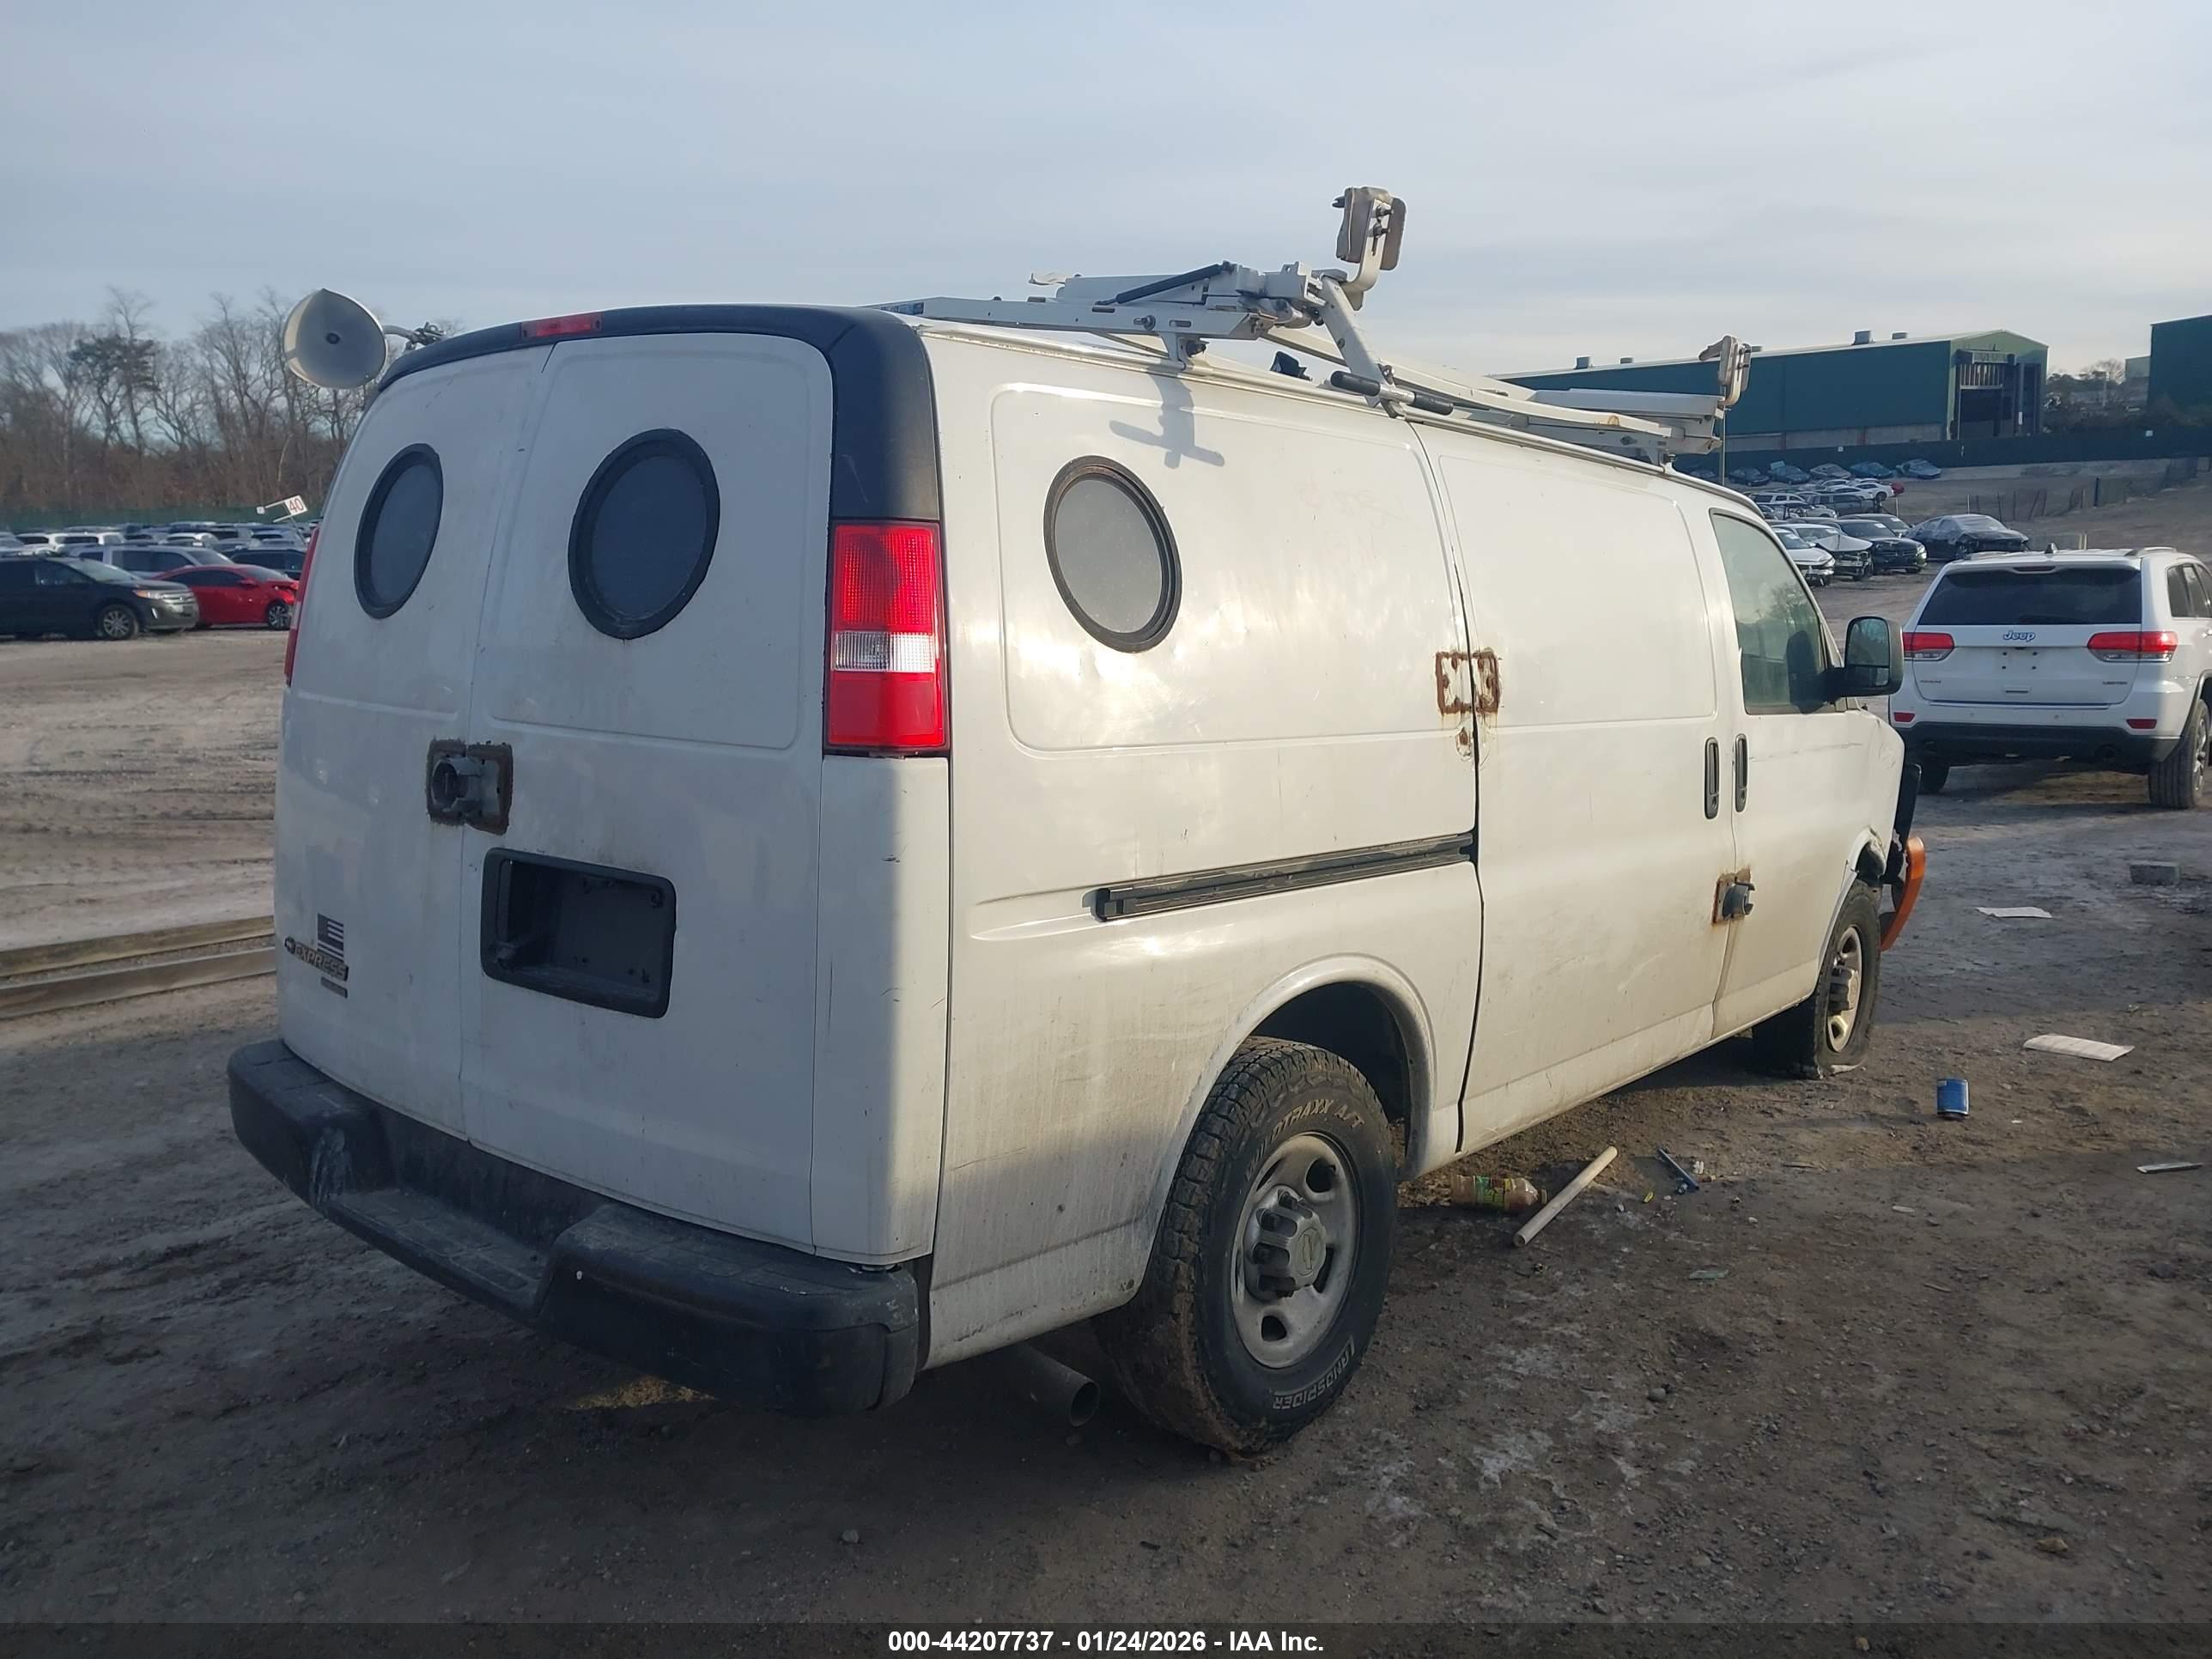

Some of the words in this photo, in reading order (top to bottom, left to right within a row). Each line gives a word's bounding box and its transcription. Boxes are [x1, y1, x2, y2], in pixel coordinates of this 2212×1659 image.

[289, 498, 304, 513] 40
[2002, 629, 2036, 642] Jeep
[295, 945, 345, 979] EXPRESS
[1273, 1335, 1355, 1410] LANDSPIDER
